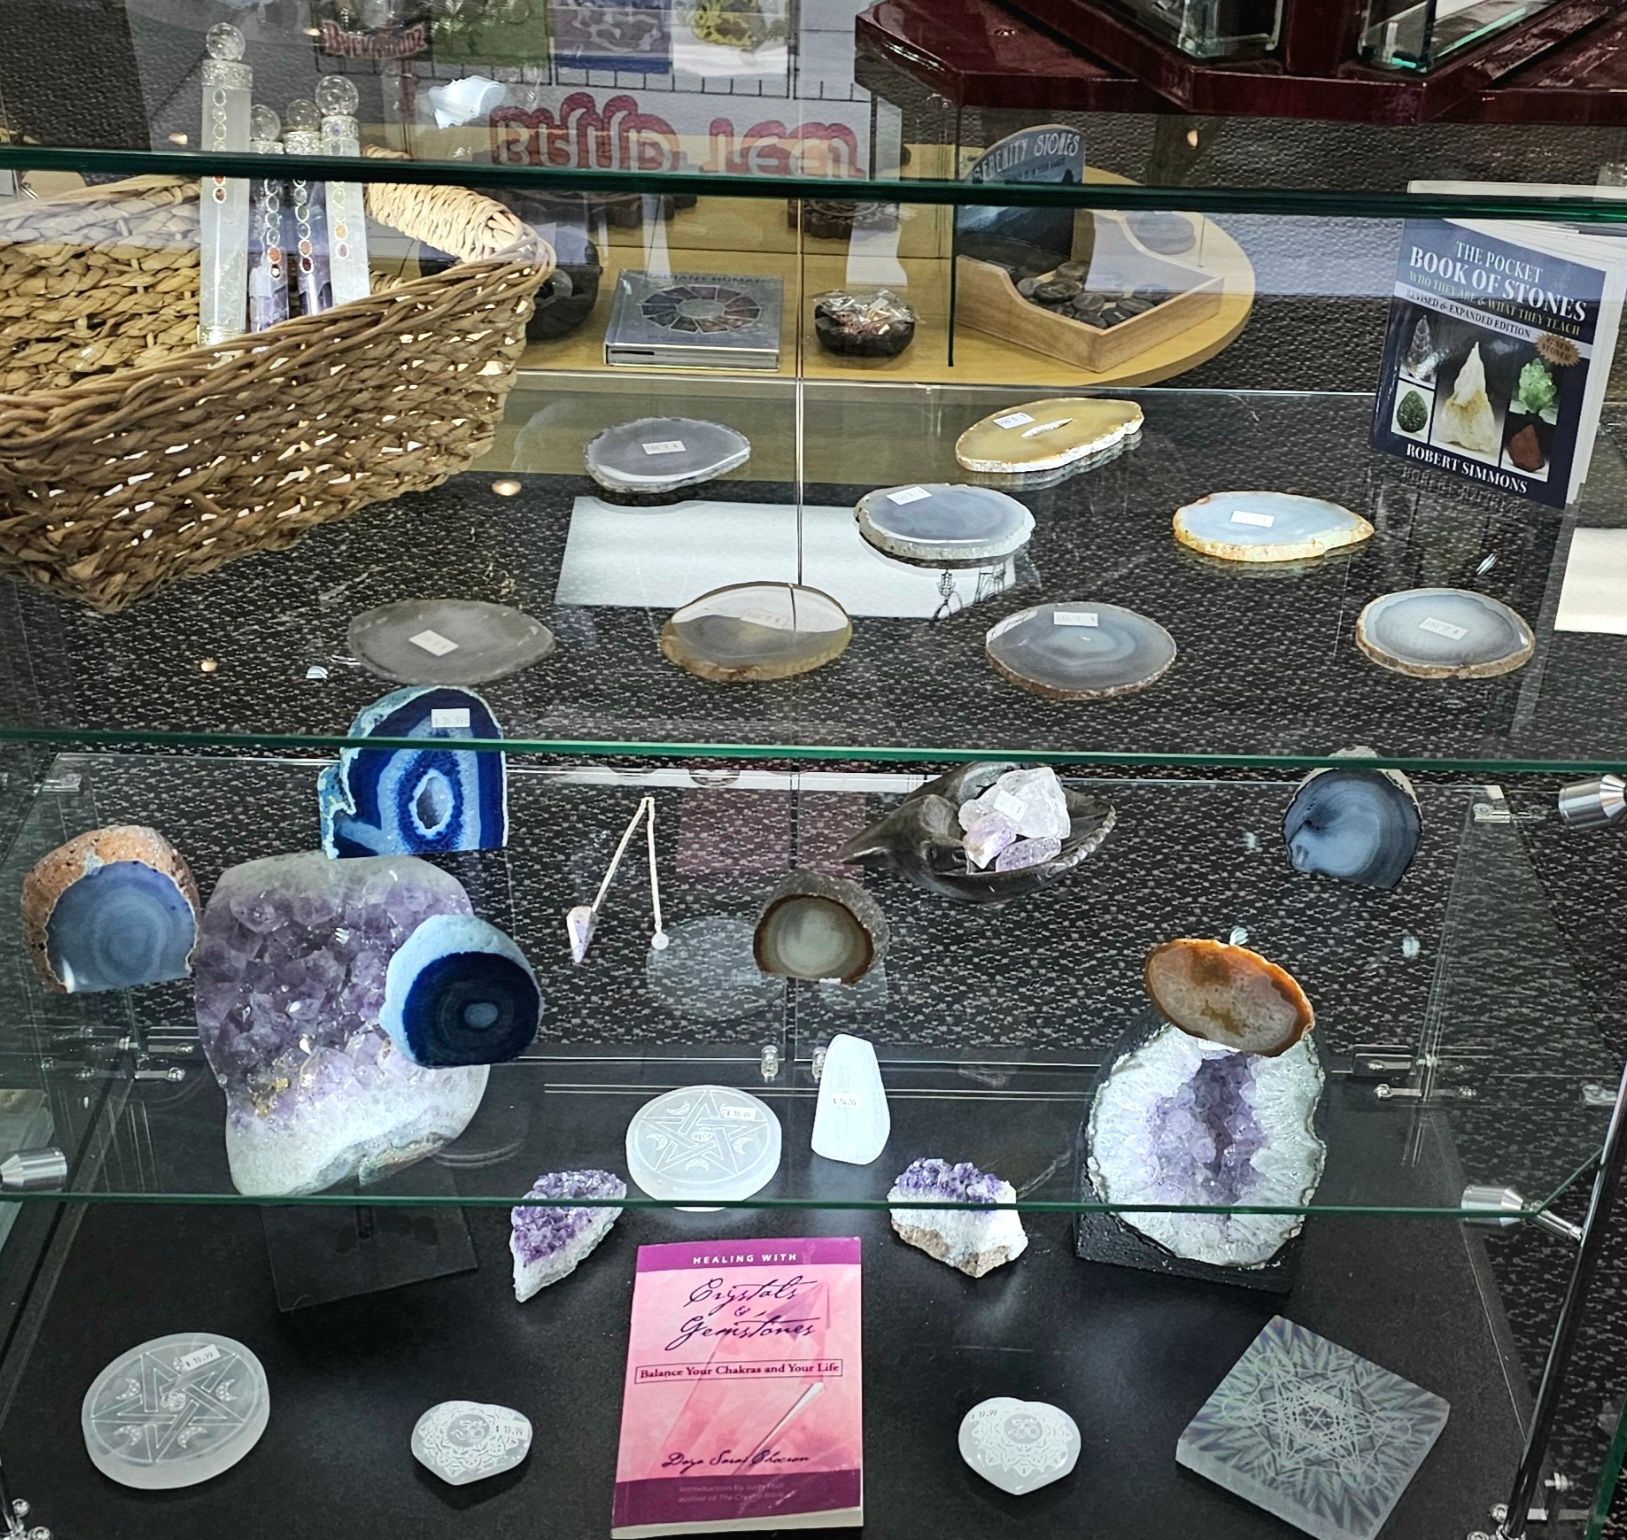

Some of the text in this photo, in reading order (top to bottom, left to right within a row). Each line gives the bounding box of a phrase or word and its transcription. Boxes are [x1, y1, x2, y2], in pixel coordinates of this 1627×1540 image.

[1034, 132, 1080, 157] STONES
[1456, 241, 1543, 283] THE POCKET
[1409, 246, 1588, 322] BOOK OF STONES
[1409, 271, 1432, 287] WHO
[1433, 279, 1456, 296] THEY
[1488, 298, 1516, 316] WHAT
[1518, 308, 1544, 328] THEY
[1545, 316, 1581, 336] TEACH
[1450, 303, 1493, 327] EXPANDED
[1494, 317, 1531, 339] EDITION
[1406, 443, 1460, 471] ROBERT
[1461, 461, 1528, 494] SIMMONS
[693, 1253, 797, 1265] HEALING WITH
[683, 1275, 818, 1316] Crystals
[665, 1315, 821, 1351] Gemstones
[640, 1362, 839, 1379] Balance Your Chakras and Your Life
